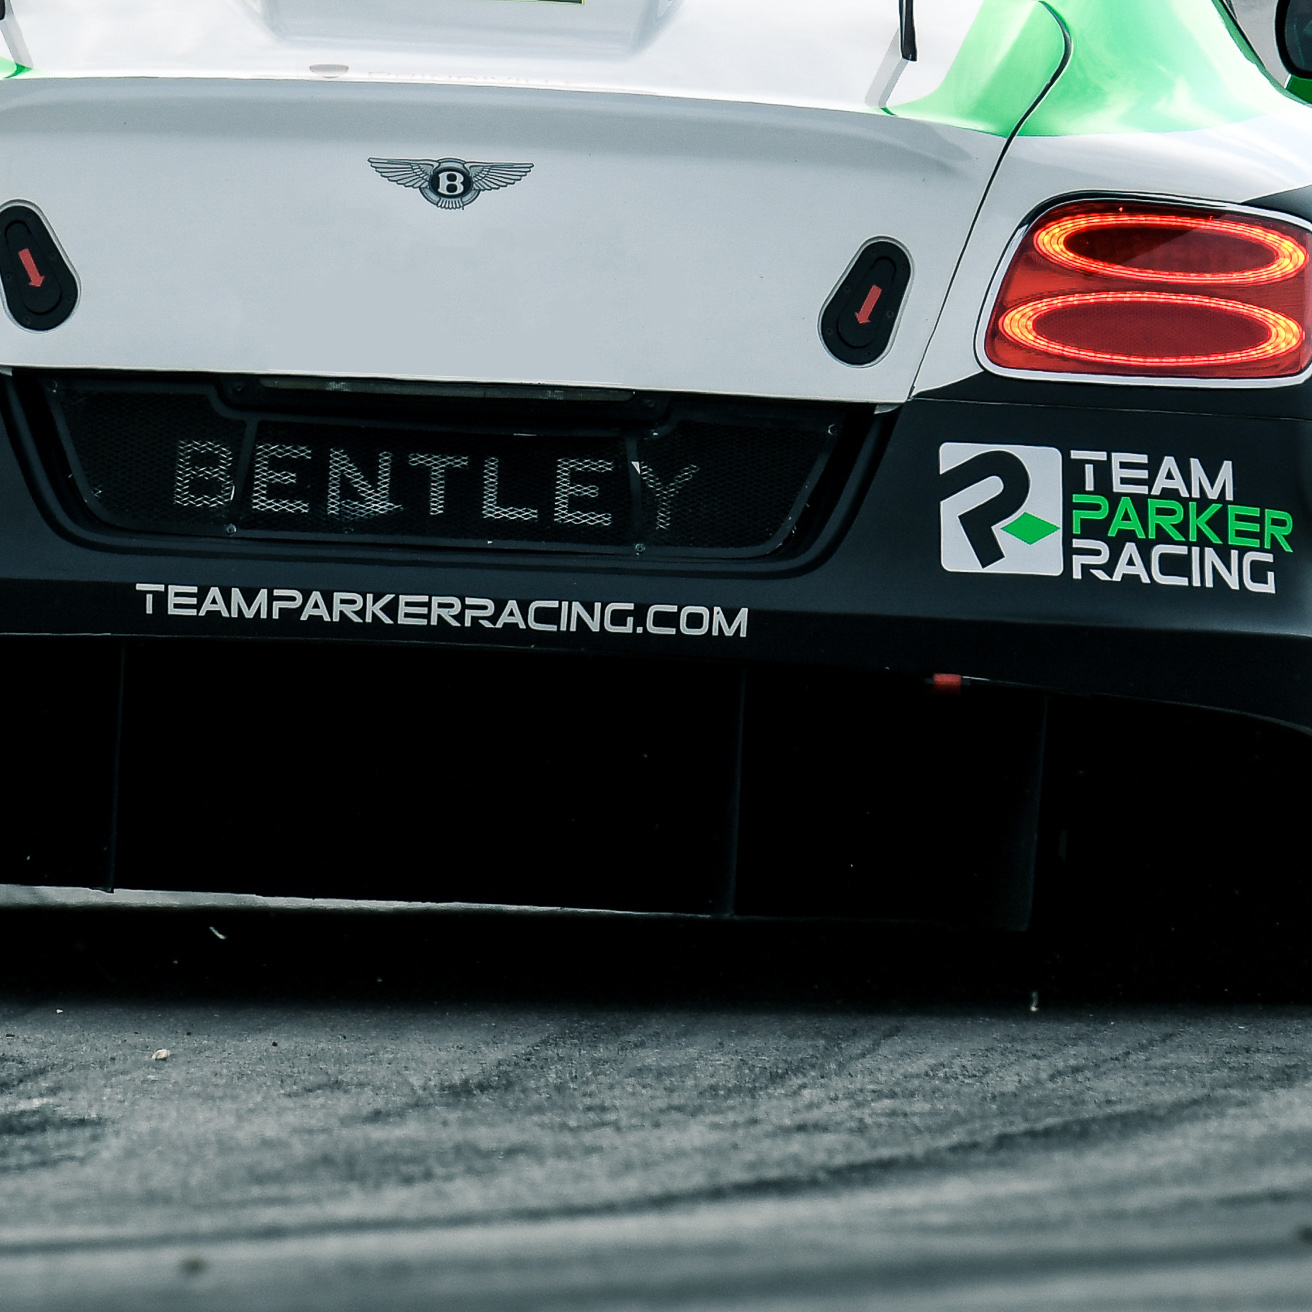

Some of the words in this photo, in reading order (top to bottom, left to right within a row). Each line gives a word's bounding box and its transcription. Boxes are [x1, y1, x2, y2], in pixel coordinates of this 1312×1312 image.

[438, 170, 465, 196] B
[174, 439, 700, 531] BENTLEY
[1070, 449, 1234, 501] TEAM
[1071, 493, 1294, 553] PARKER
[1072, 538, 1276, 594] RACING
[135, 583, 749, 638] TEAMPARKERRACING.COM
